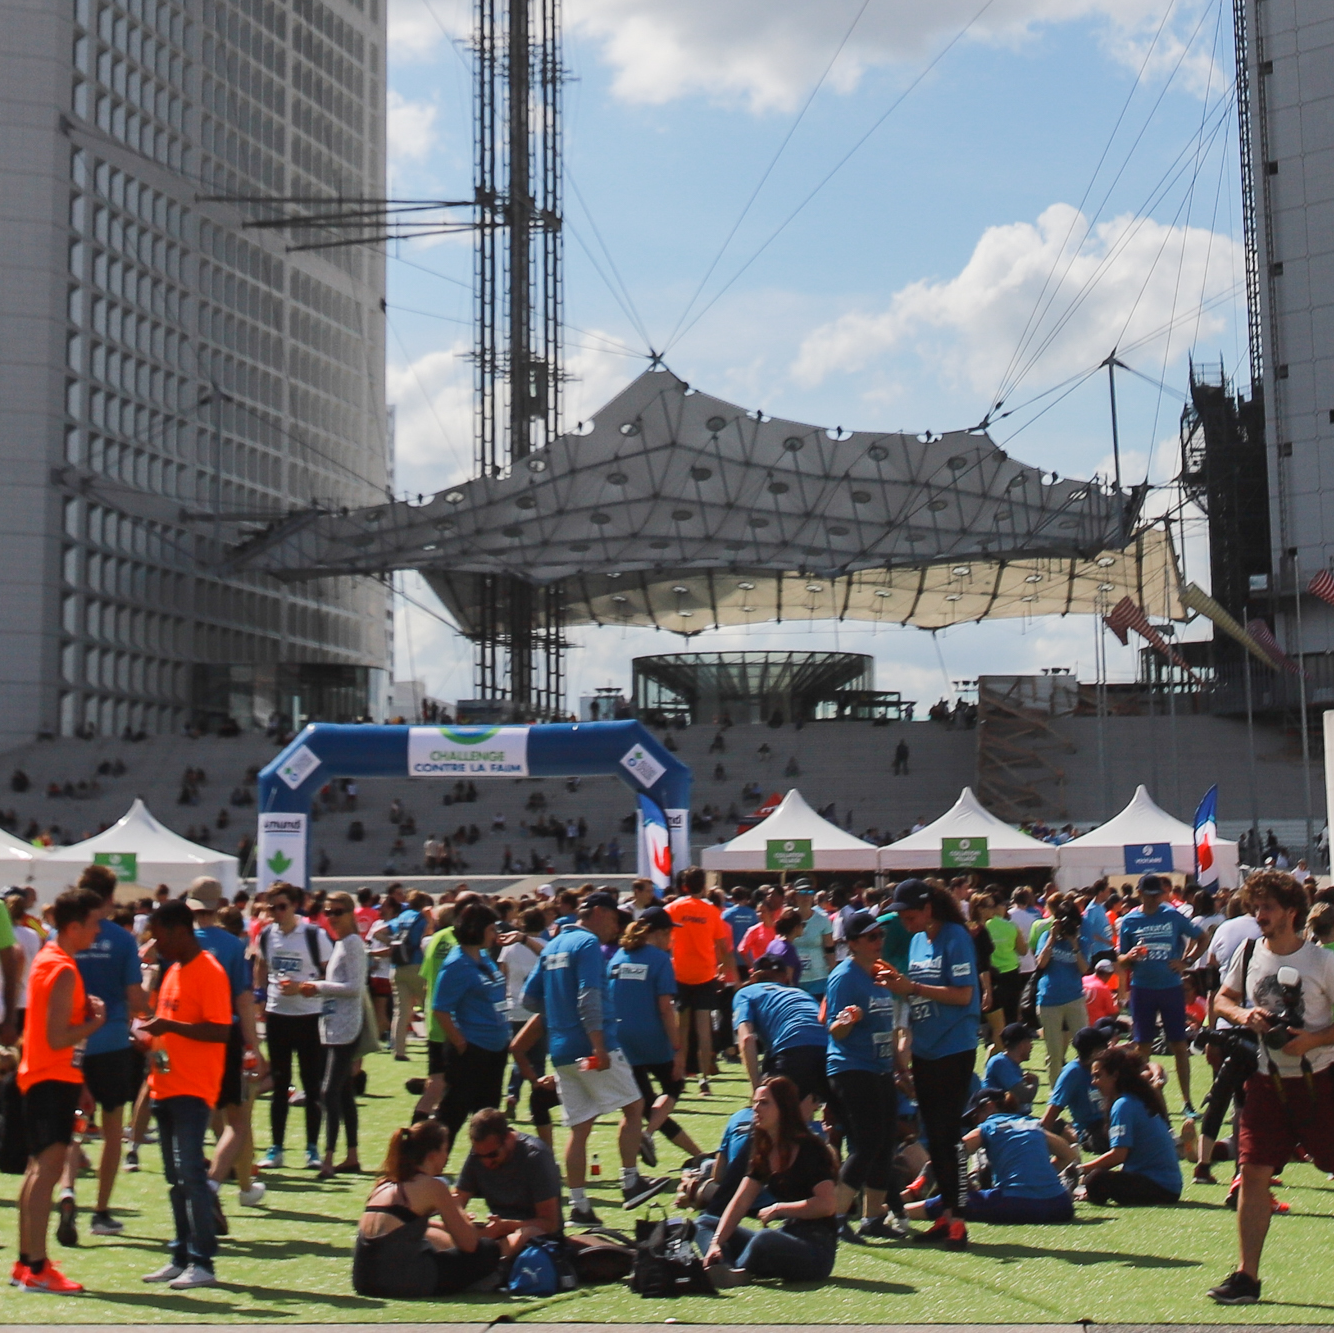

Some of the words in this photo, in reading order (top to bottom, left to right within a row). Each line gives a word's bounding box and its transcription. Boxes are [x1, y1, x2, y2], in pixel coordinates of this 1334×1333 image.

[429, 750, 505, 762] CHALLENGE
[414, 763, 466, 772] CONTRE
[470, 763, 486, 772] LA
[490, 763, 522, 773] FAIM
